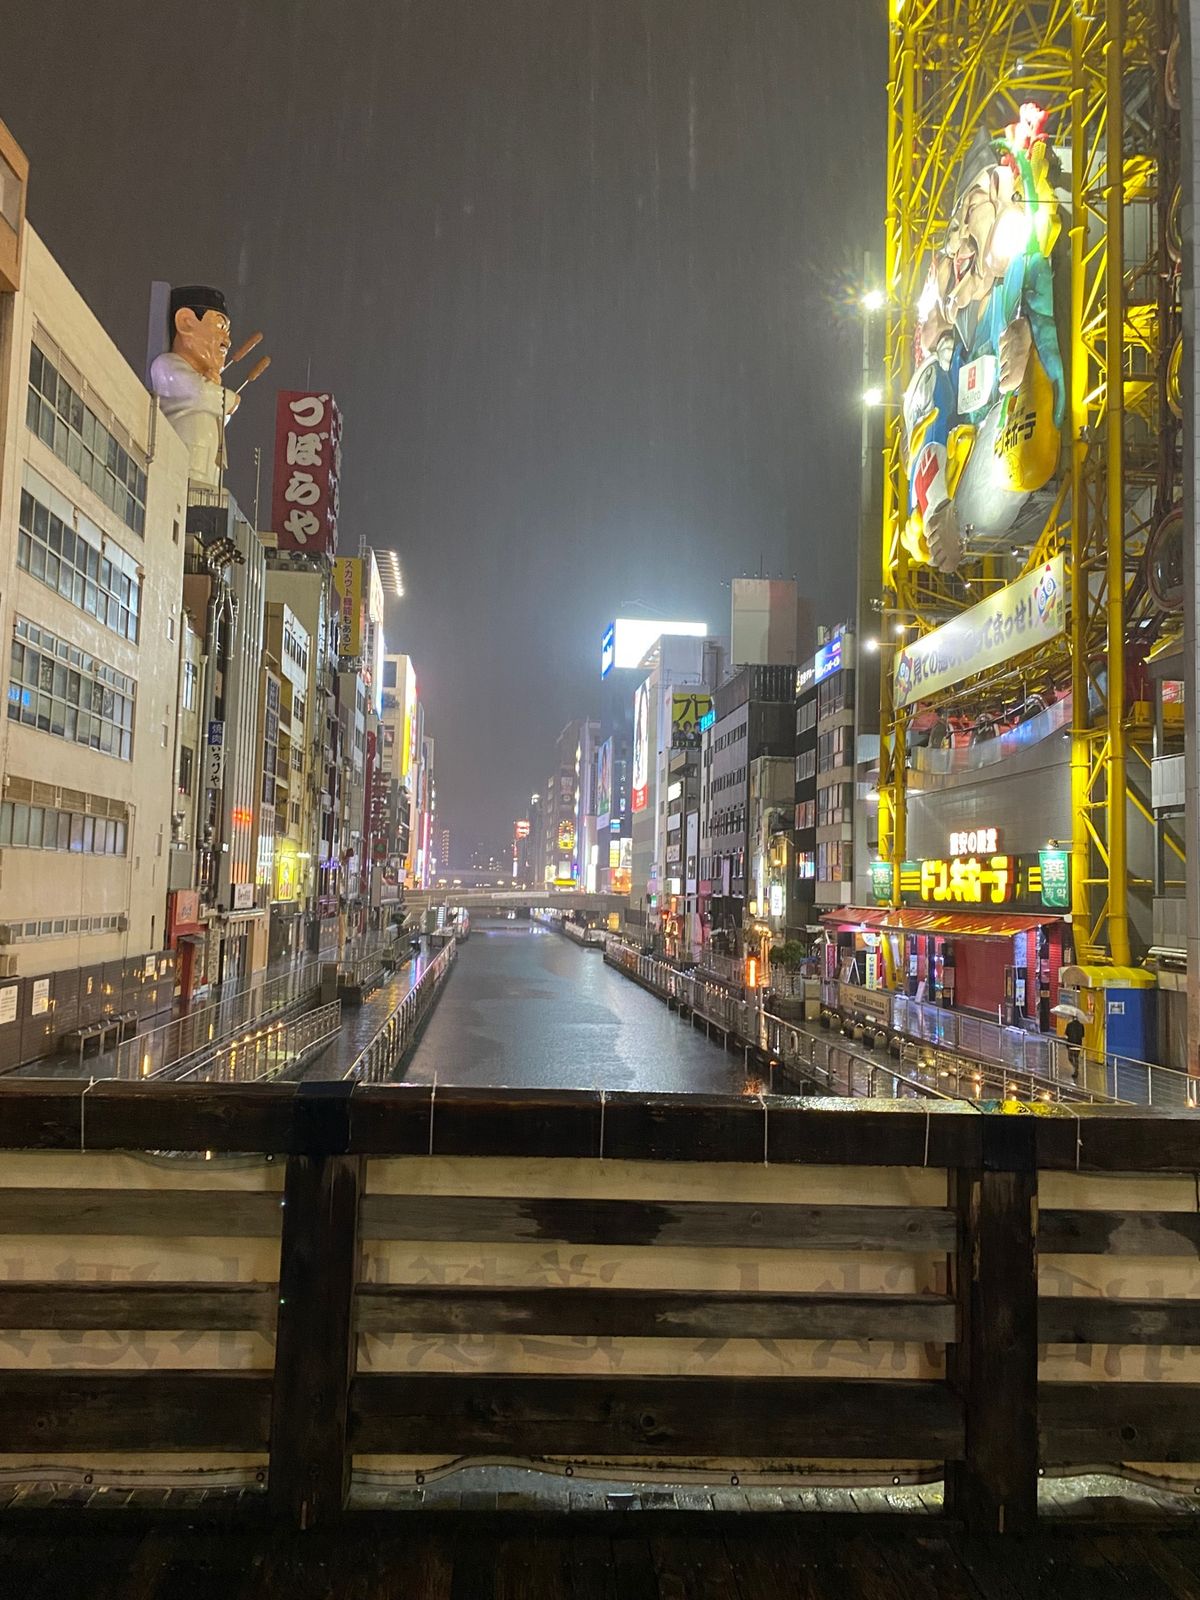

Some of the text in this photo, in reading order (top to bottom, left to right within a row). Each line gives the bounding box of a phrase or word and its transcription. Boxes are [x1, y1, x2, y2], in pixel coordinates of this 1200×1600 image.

[284, 394, 329, 544] づぼらや
[1042, 859, 1066, 882] 薬
